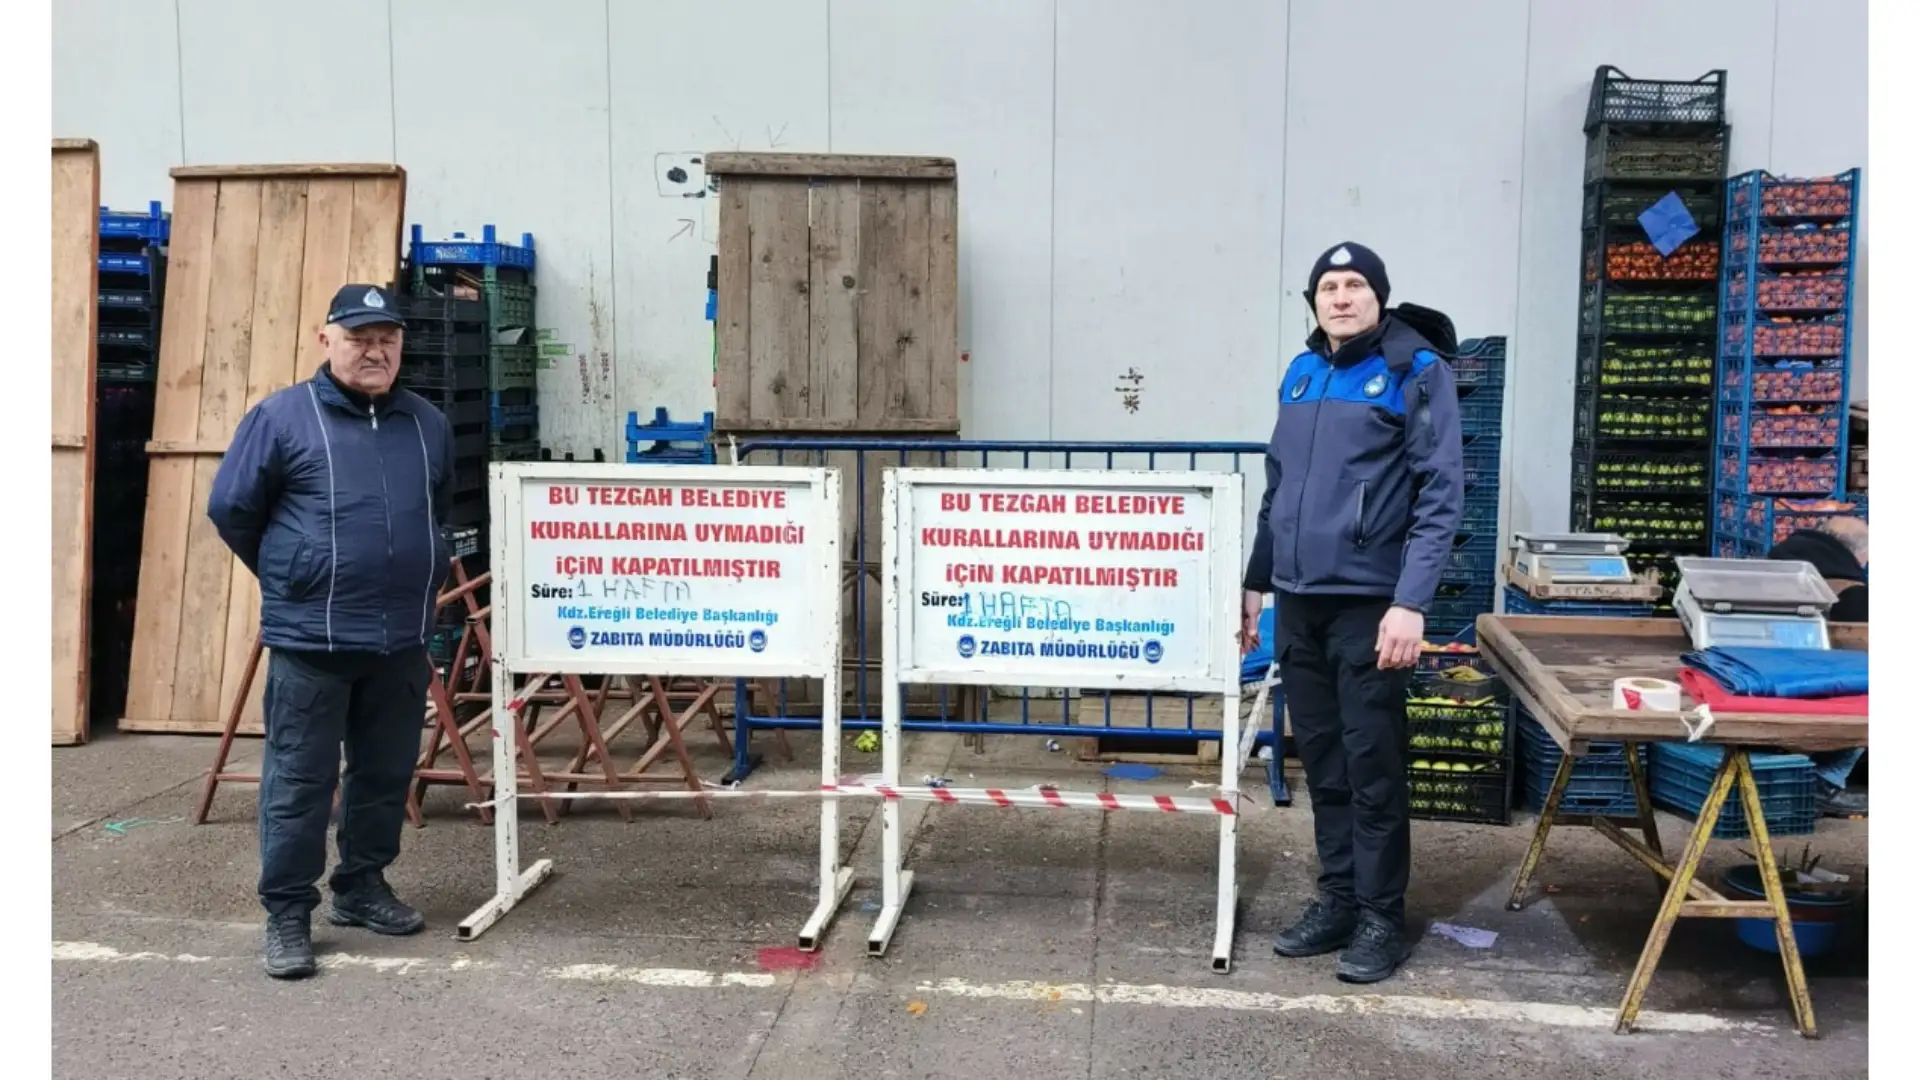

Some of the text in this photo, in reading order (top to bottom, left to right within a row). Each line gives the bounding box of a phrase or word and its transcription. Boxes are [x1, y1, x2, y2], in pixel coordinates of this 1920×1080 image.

[549, 486, 579, 505] BU
[587, 487, 673, 507] TEZGAH
[941, 492, 970, 512] BU
[979, 493, 1066, 513] TEZGAH
[531, 521, 804, 545] KURALLARINA UYMADIĞI
[922, 527, 1204, 552] KURALLARINA UYMADIĞI
[611, 557, 781, 582] KAPATILMIŞTIR
[1003, 564, 1178, 592] KAPATILMIŞTIR
[531, 583, 573, 599] Süre:
[576, 578, 691, 603] 1 HAFTA
[921, 591, 963, 607] Süre:
[636, 606, 698, 623] Belediye
[703, 608, 779, 626] Başkanlığı
[1026, 615, 1091, 634] Belediye
[1096, 618, 1175, 636] Başkanlığı
[590, 629, 745, 649] ZABITA MÜDÜRLÜĞÜ
[980, 638, 1140, 659] ZABITA MÜDÜRLÜĞÜ
